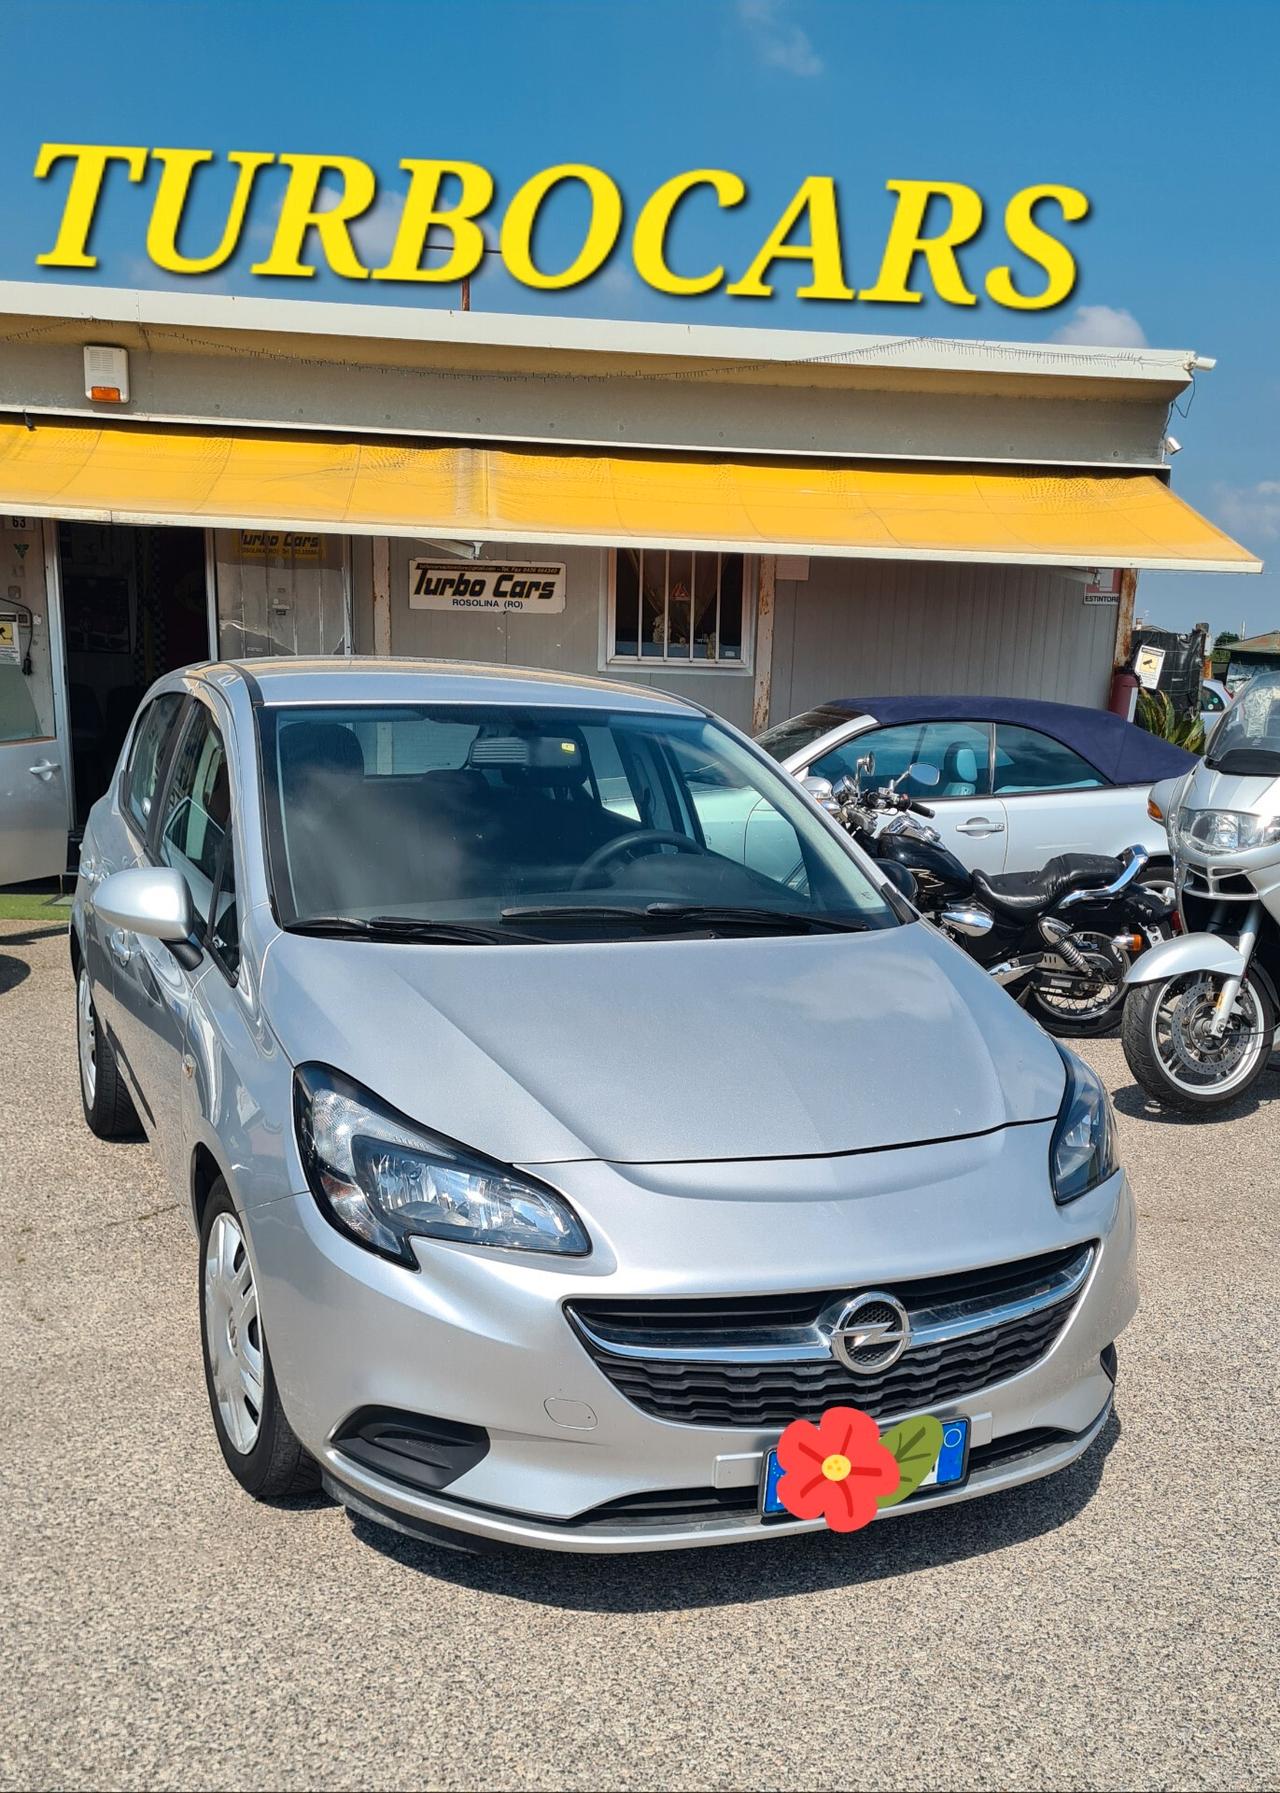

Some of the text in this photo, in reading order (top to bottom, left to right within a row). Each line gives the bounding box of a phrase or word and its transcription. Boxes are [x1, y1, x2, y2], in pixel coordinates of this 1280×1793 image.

[414, 567, 556, 599] Turbo Cars
[452, 599, 523, 609] ROSOLINA (RO)
